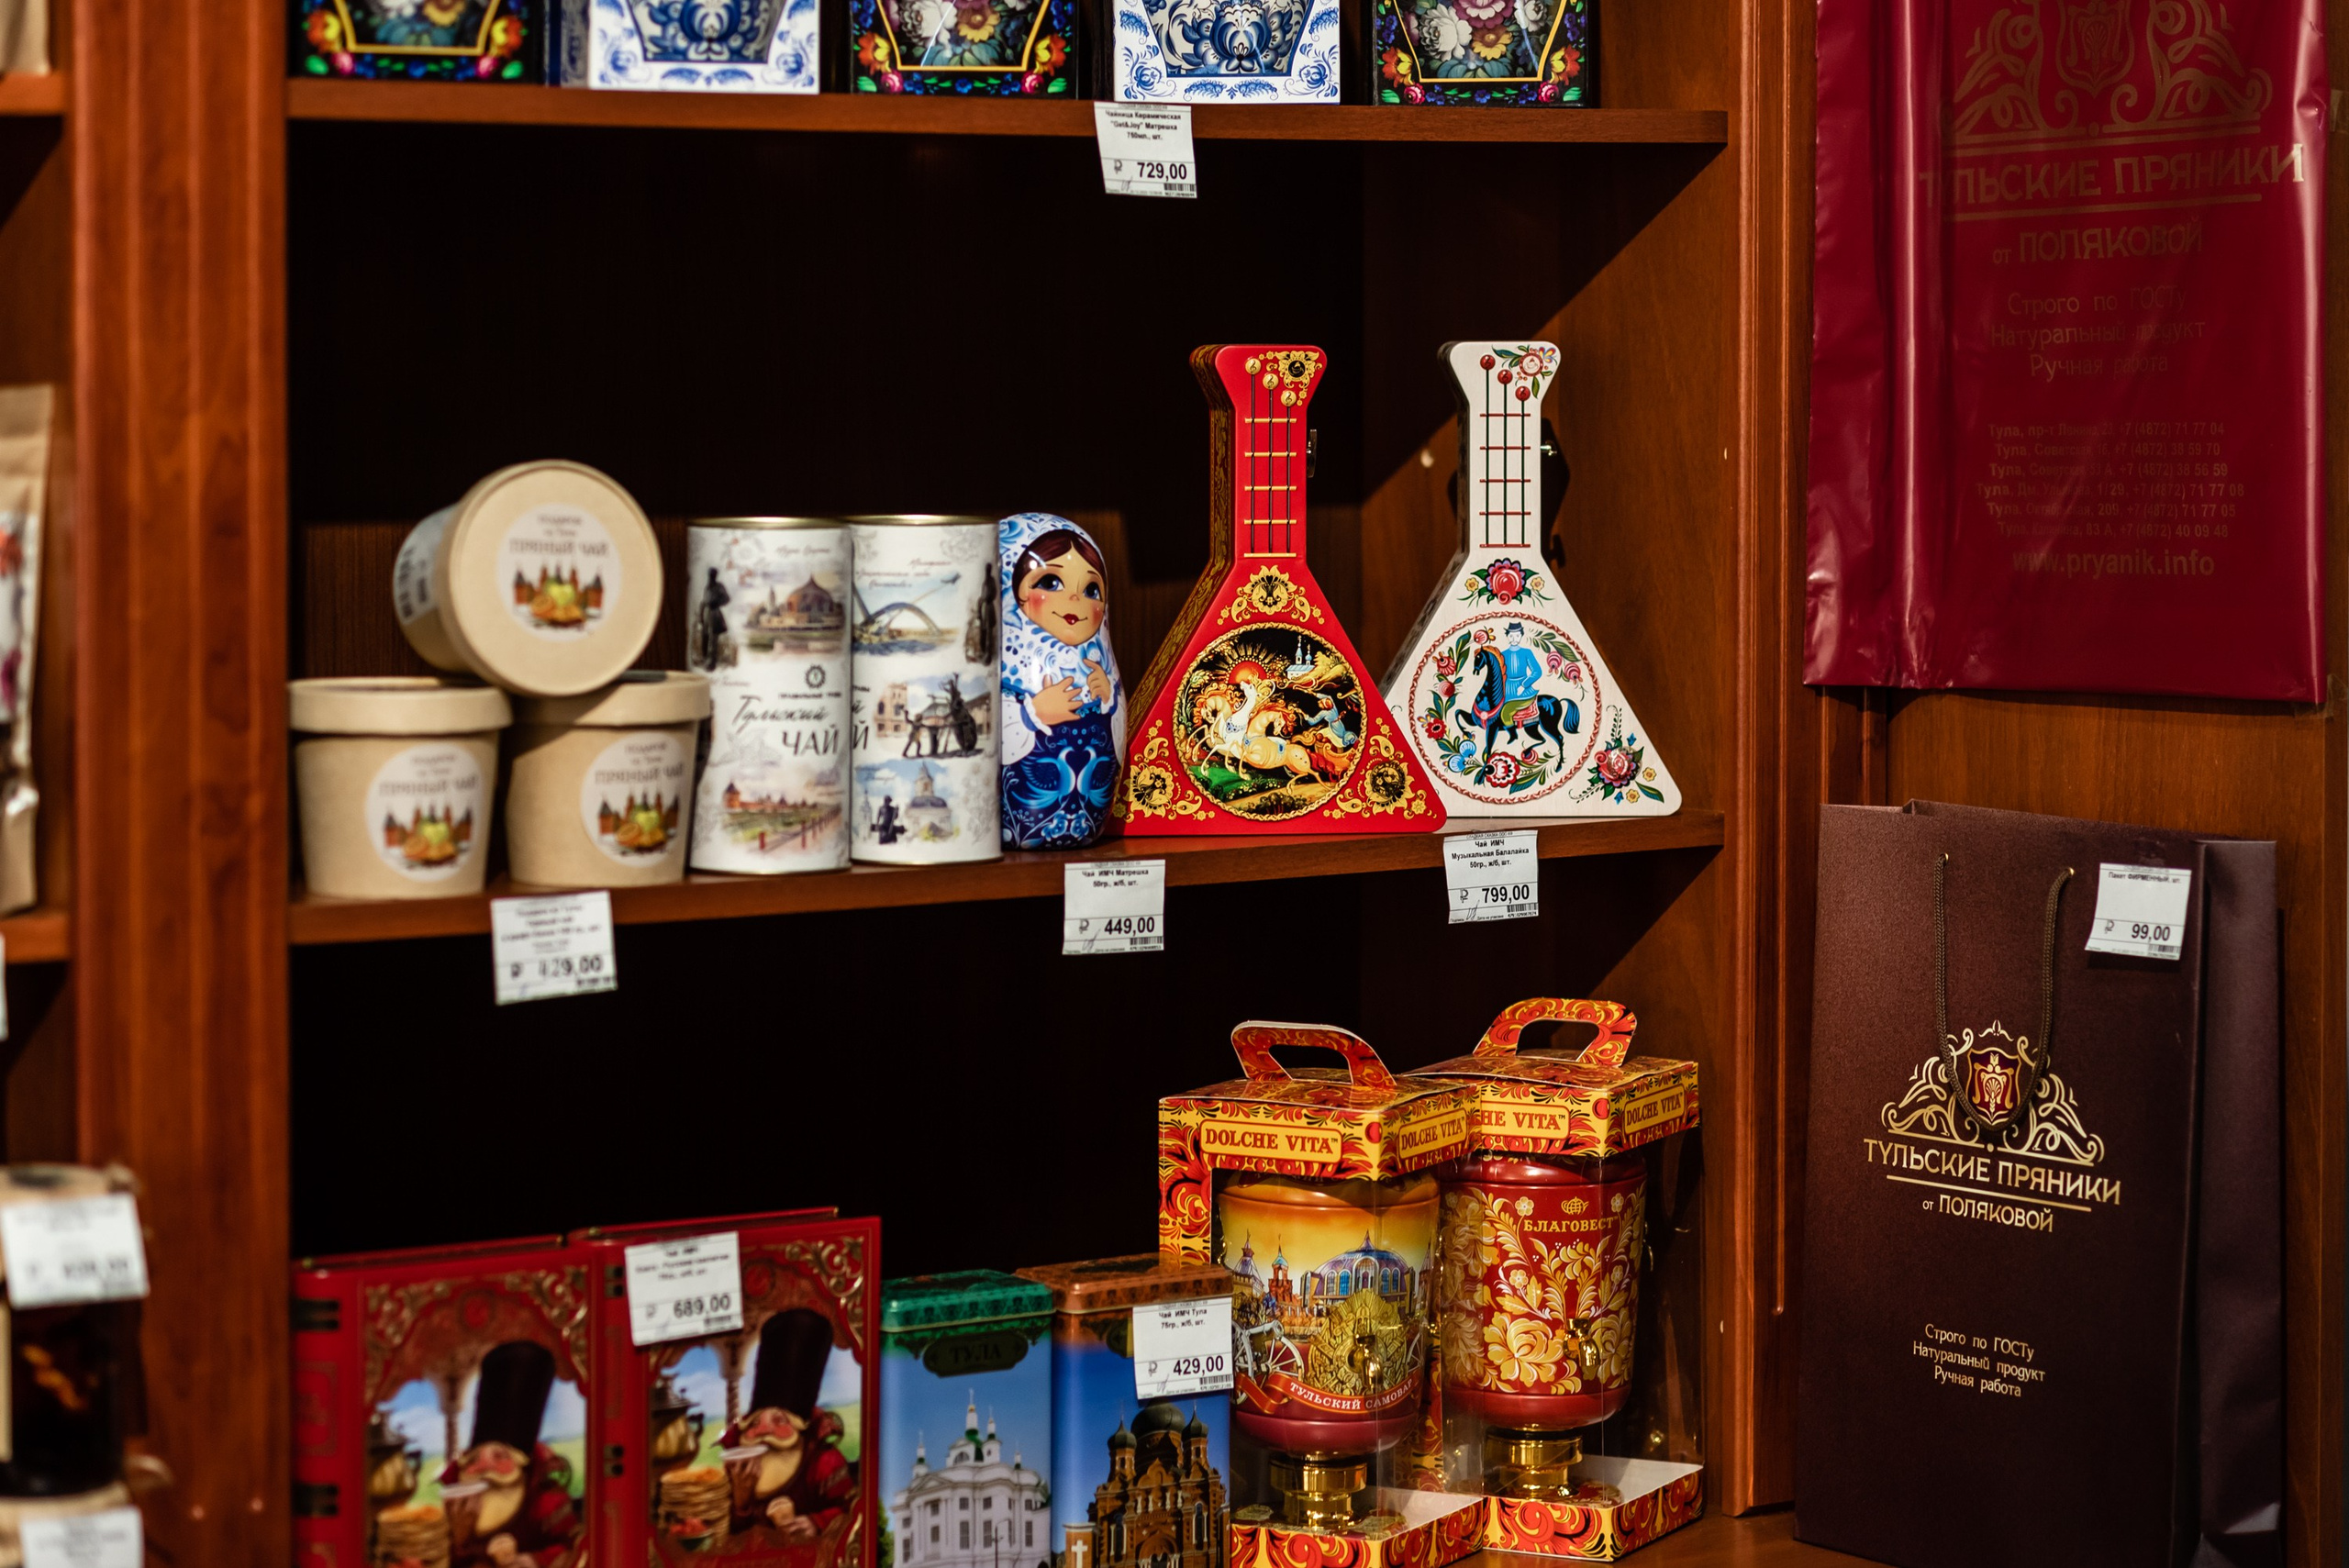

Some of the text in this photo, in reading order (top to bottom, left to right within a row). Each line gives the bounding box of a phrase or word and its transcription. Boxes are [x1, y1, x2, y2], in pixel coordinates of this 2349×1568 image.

[1135, 111, 1181, 120] Керамическая
[1145, 122, 1177, 130] Матрешка
[1137, 161, 1187, 183] 729,00
[1919, 143, 2306, 207] ТЛЬСКИЕ ПРЯНИКИ
[1992, 215, 2203, 264] от ПОЛЯКОВОЙ
[2008, 292, 2080, 320] Строго
[2093, 294, 2119, 312] по
[1990, 321, 2126, 350] Натуральный
[2030, 354, 2104, 383] Ручная
[2175, 422, 2188, 435] 71
[2192, 422, 2206, 435] 77
[2210, 422, 2224, 436] 04
[2171, 443, 2184, 456] 38
[2188, 443, 2202, 456] 59
[2206, 443, 2221, 456] 70
[2176, 462, 2190, 476] 38
[2194, 462, 2209, 476] 56
[2212, 462, 2229, 476] 59
[2189, 483, 2204, 496] 71
[2209, 483, 2225, 496] 77
[2229, 483, 2244, 497] 08
[2182, 504, 2197, 517] 71
[2201, 504, 2217, 517] 77
[2221, 504, 2236, 517] 05
[2175, 524, 2191, 538] 40
[2194, 524, 2210, 538] 09
[2213, 524, 2229, 538] 48
[2012, 549, 2215, 580] www.pryanik.info
[782, 724, 840, 756] ЧАЙ
[1490, 839, 1505, 847] ИМЧ
[1452, 848, 1530, 861] Музыкальная Балалайка
[1470, 861, 1486, 869] 50гр.,
[1116, 868, 1149, 877] Матрешка
[1482, 884, 1530, 905] 799,00
[1104, 917, 1155, 937] 449,00
[2132, 923, 2171, 942] 99,00
[1626, 1100, 1659, 1127] DOLCHE
[1205, 1128, 1278, 1151] DOLCHE
[1401, 1125, 1438, 1151] DOLCHE
[1864, 1138, 2121, 1206] ТУЛЬСКИЕ ПРЯНИКИ
[1922, 1194, 2054, 1233] от ПОЛЯКОВОЙ
[1175, 1309, 1190, 1318] ИМЧ
[1192, 1308, 1208, 1317] Тула
[1924, 1323, 2034, 1362] Строго по ГОСТу
[1173, 1355, 1224, 1376] 429,00
[1913, 1340, 2046, 1383] Натуральный продукт
[1934, 1364, 2021, 1397] Ручная работа
[1289, 1378, 1413, 1410] ТУЛЬСКИЙ САМОВАР
